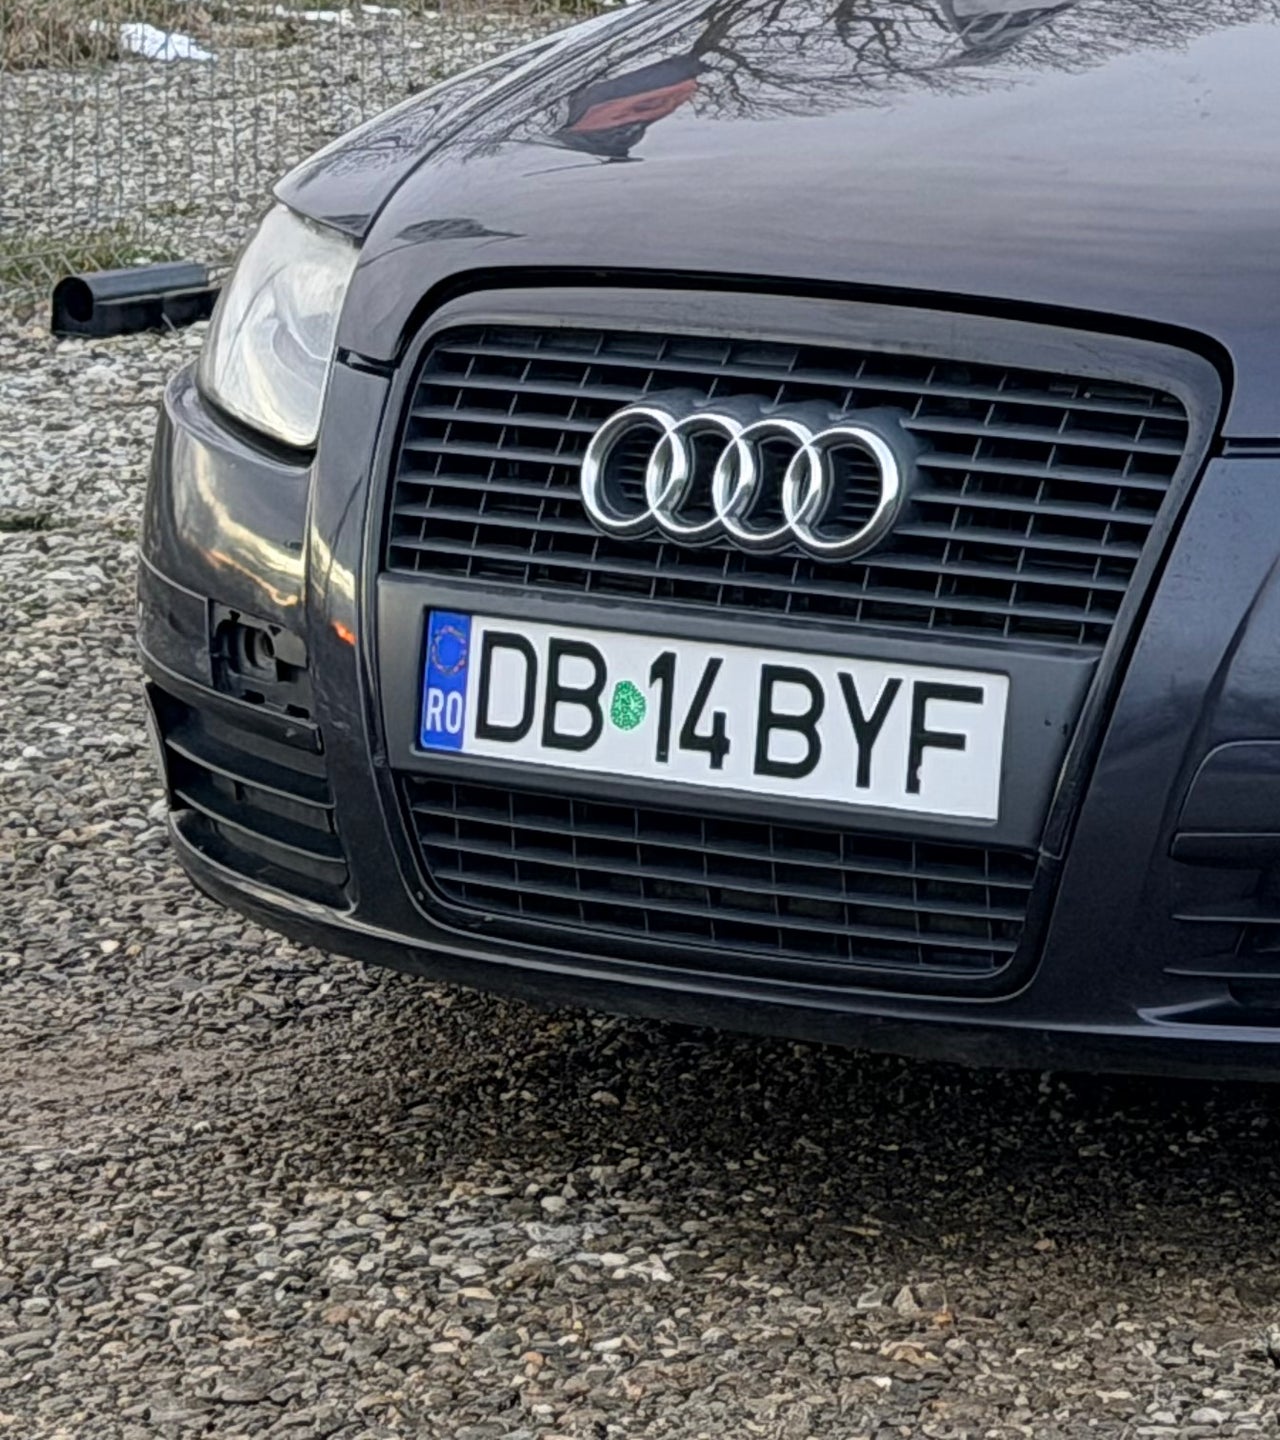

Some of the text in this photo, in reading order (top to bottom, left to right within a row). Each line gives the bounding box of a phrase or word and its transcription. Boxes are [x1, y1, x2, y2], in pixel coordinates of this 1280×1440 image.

[424, 686, 463, 736] RO
[473, 629, 607, 752] DB
[648, 651, 731, 770] 14
[752, 663, 985, 795] BYF
